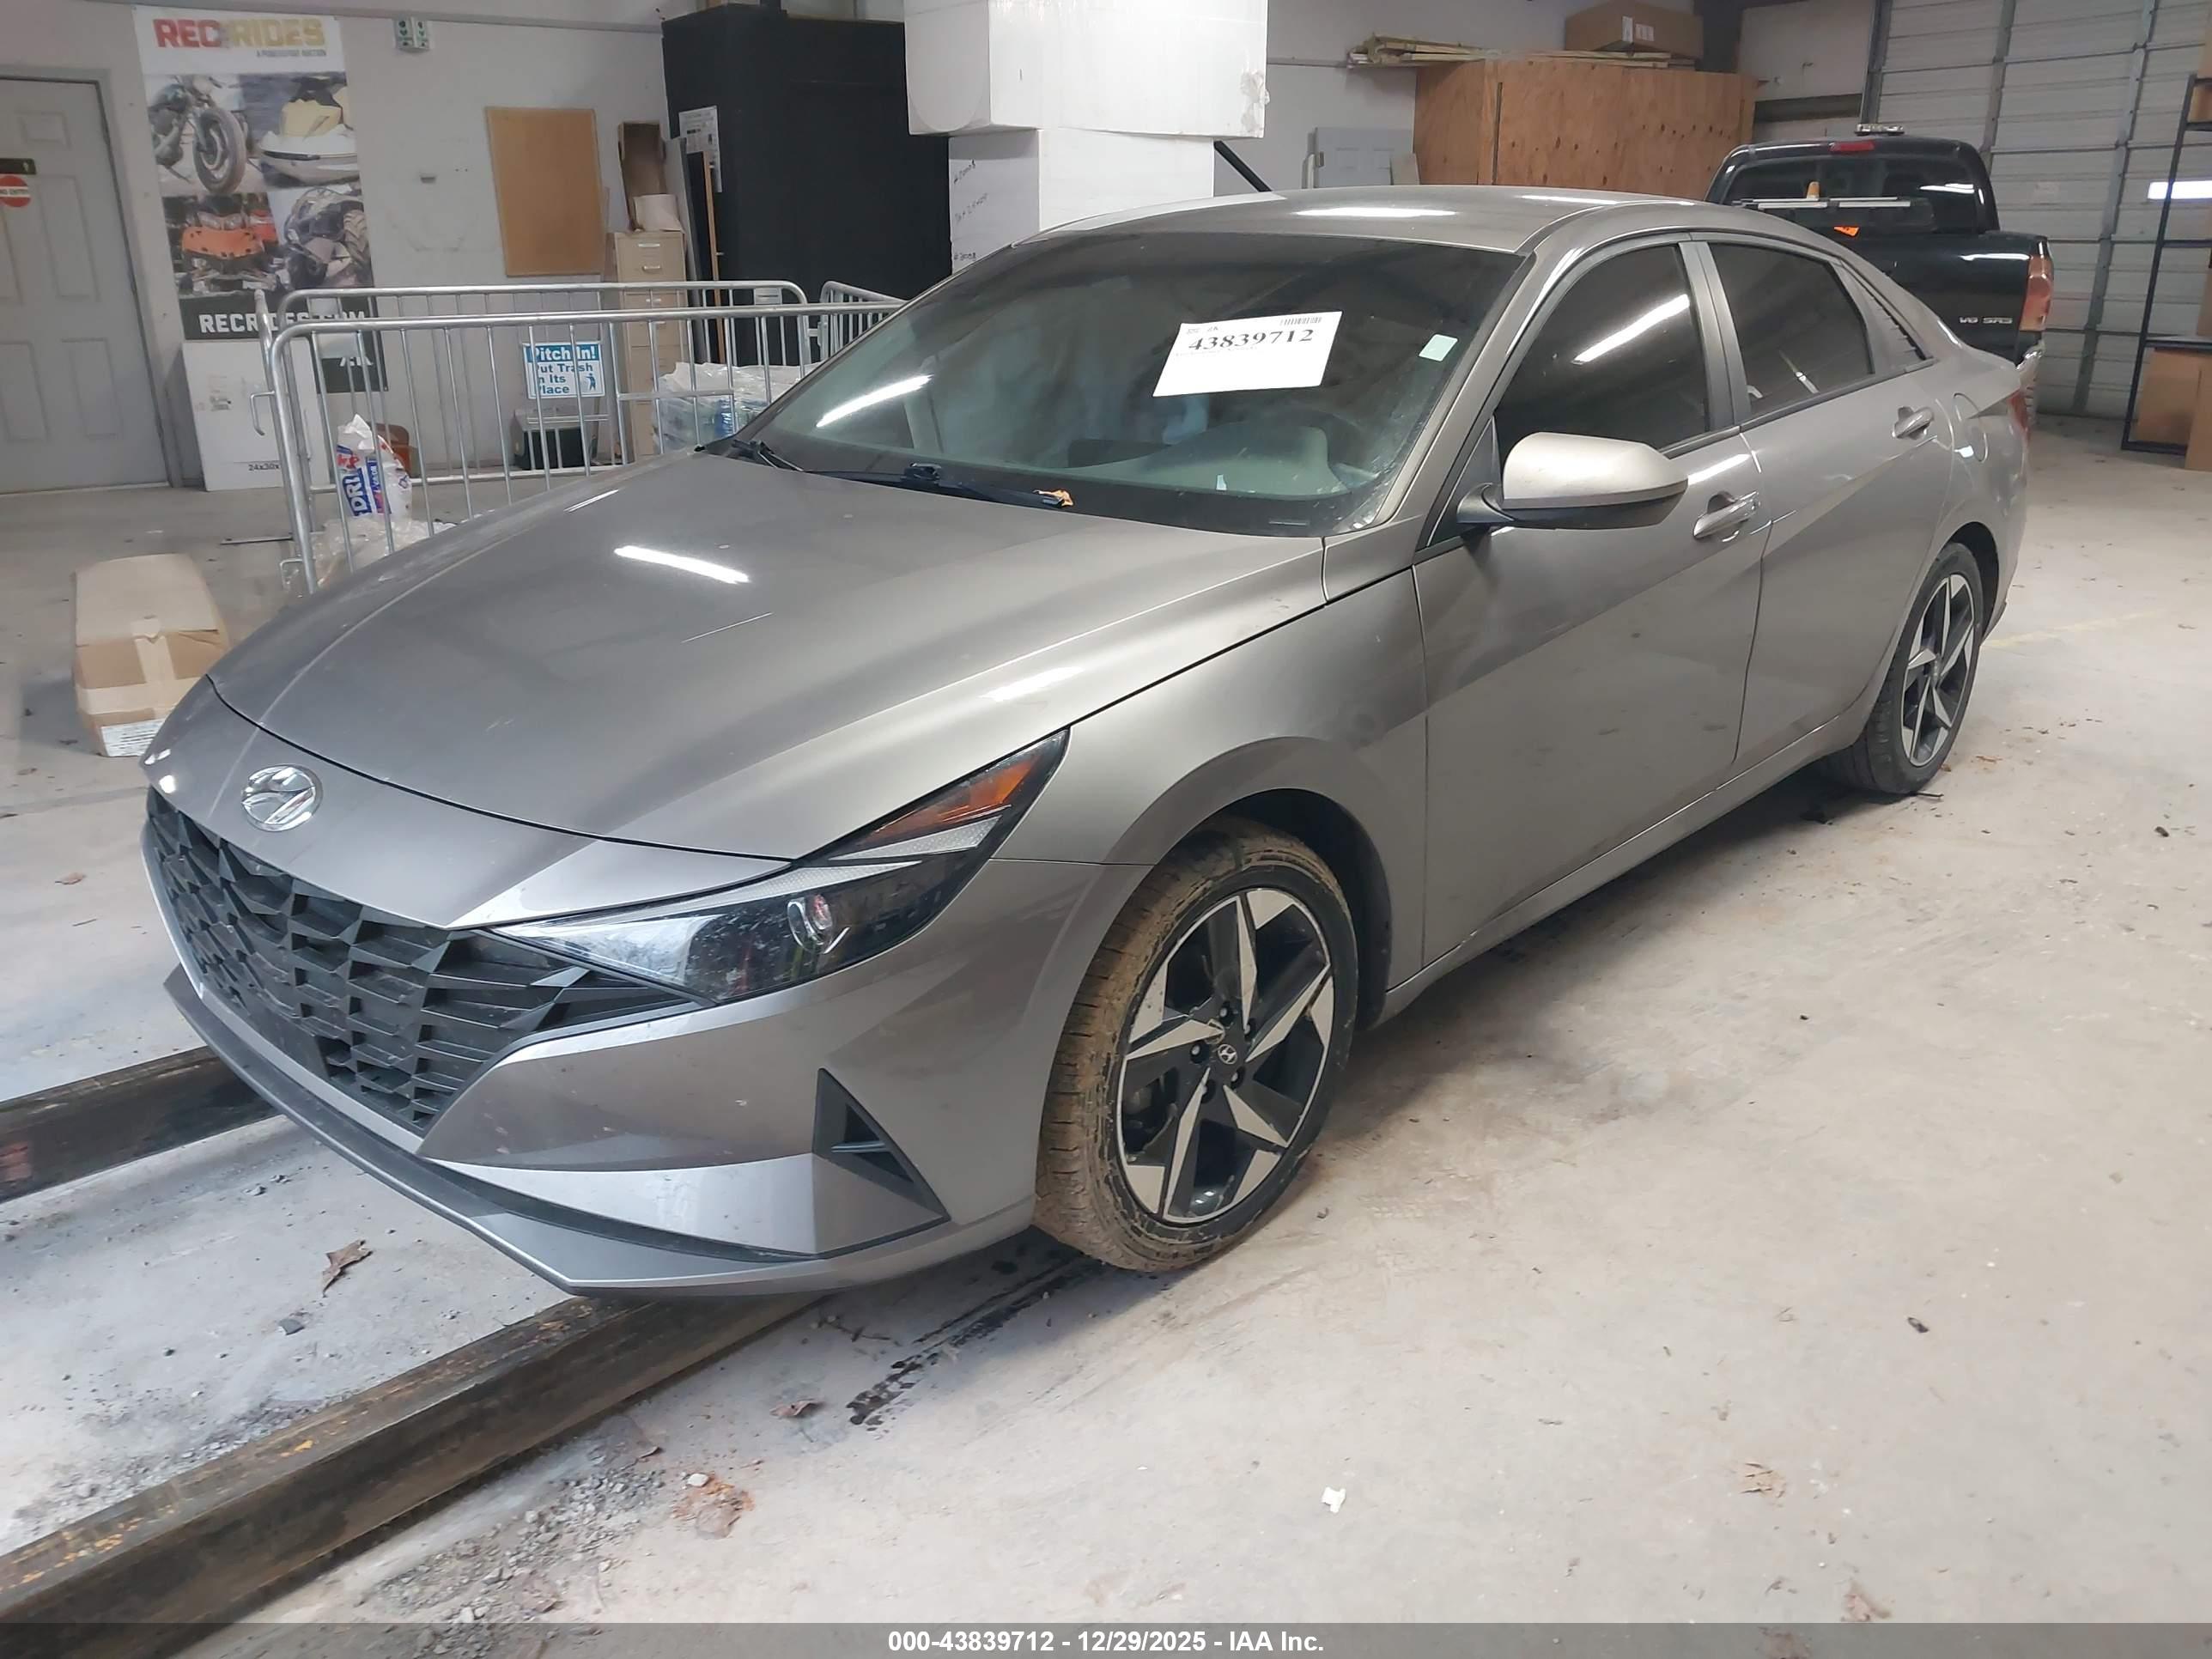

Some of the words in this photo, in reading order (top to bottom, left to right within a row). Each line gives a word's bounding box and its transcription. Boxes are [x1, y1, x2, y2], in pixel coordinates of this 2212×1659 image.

[1188, 329, 1315, 350] 43839712
[576, 345, 596, 360] In!
[537, 363, 553, 374] ut
[550, 374, 567, 384] Its
[539, 385, 570, 394] lace
